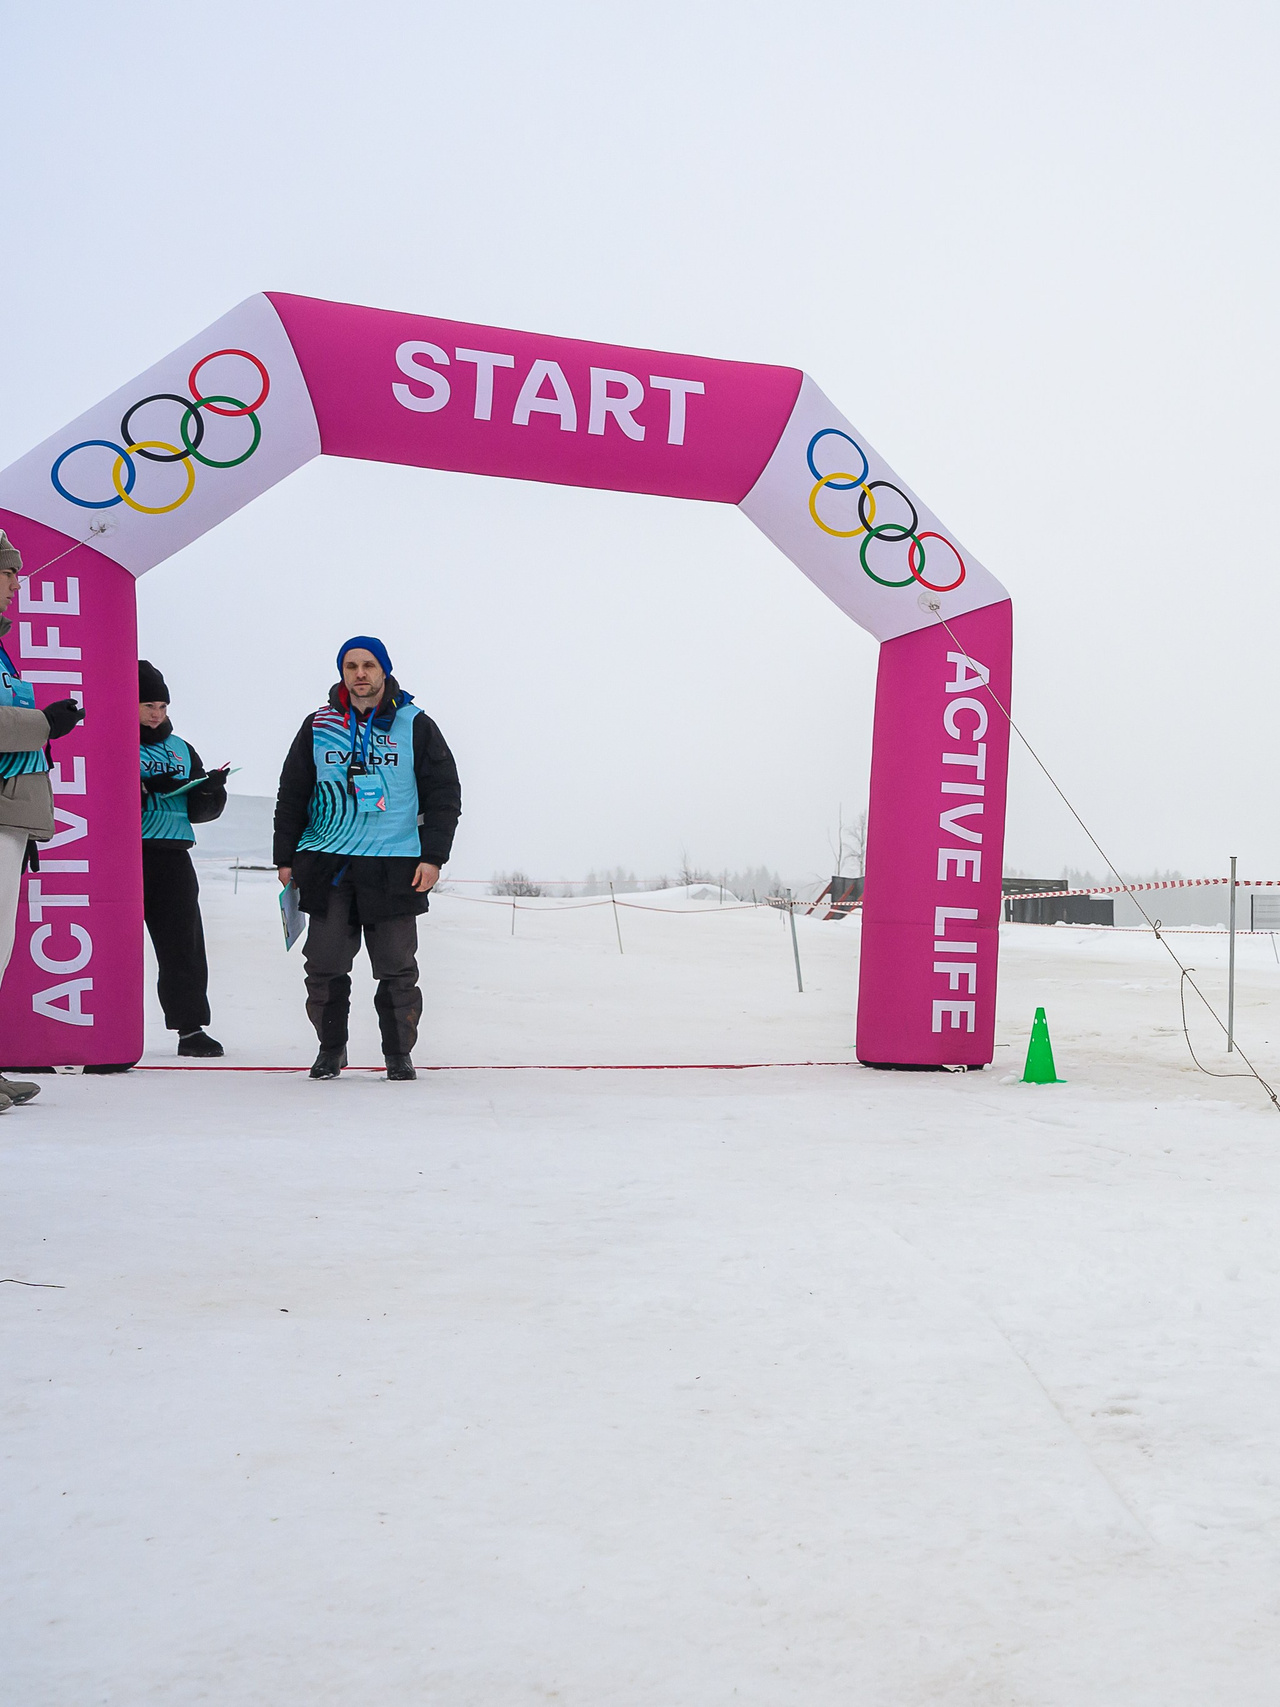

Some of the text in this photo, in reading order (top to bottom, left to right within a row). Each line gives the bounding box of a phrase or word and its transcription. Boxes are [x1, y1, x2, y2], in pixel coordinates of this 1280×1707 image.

[391, 339, 706, 446] START
[17, 575, 85, 727] IFE
[324, 750, 399, 767] СУЬЯ
[931, 650, 990, 1034] ACTIVE LIFE
